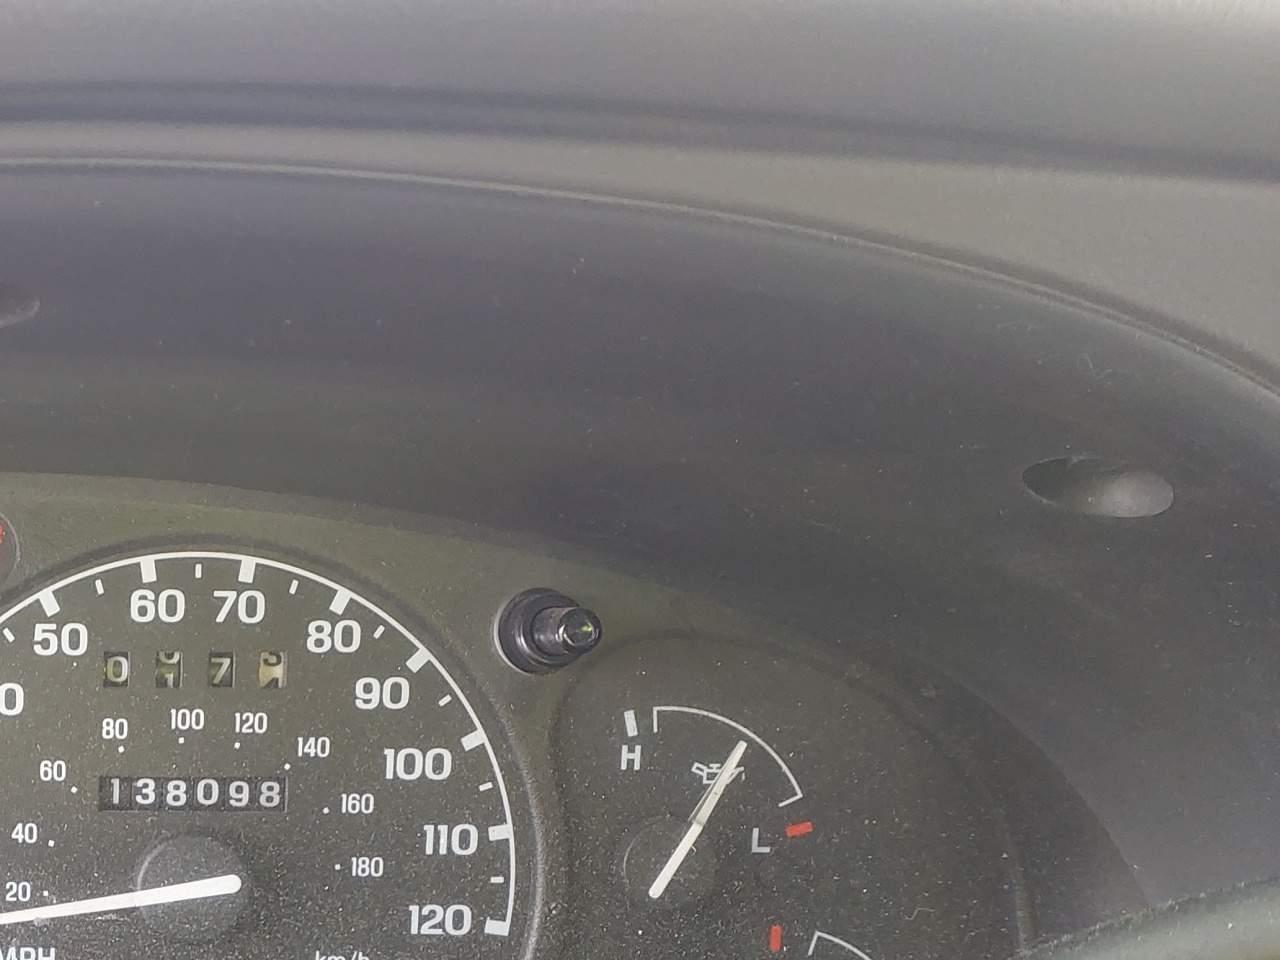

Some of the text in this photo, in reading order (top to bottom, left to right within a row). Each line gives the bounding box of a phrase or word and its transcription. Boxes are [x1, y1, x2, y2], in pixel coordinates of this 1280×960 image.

[131, 589, 185, 622] 60
[214, 591, 265, 623] 70
[34, 623, 87, 655] 50
[307, 620, 361, 653] 80
[356, 677, 409, 709] 90
[102, 718, 127, 739] 80
[171, 709, 204, 729] 100
[235, 713, 267, 733] 120
[298, 737, 329, 757] 140
[621, 745, 641, 770] H
[40, 760, 66, 781] 60
[384, 748, 451, 780] 100
[111, 779, 279, 806] 138098
[342, 794, 374, 813] 160
[12, 823, 37, 843] 40
[424, 824, 478, 855] 110
[752, 828, 770, 852] L
[352, 857, 383, 876] 180
[6, 882, 30, 901] 20
[409, 905, 471, 935] 120
